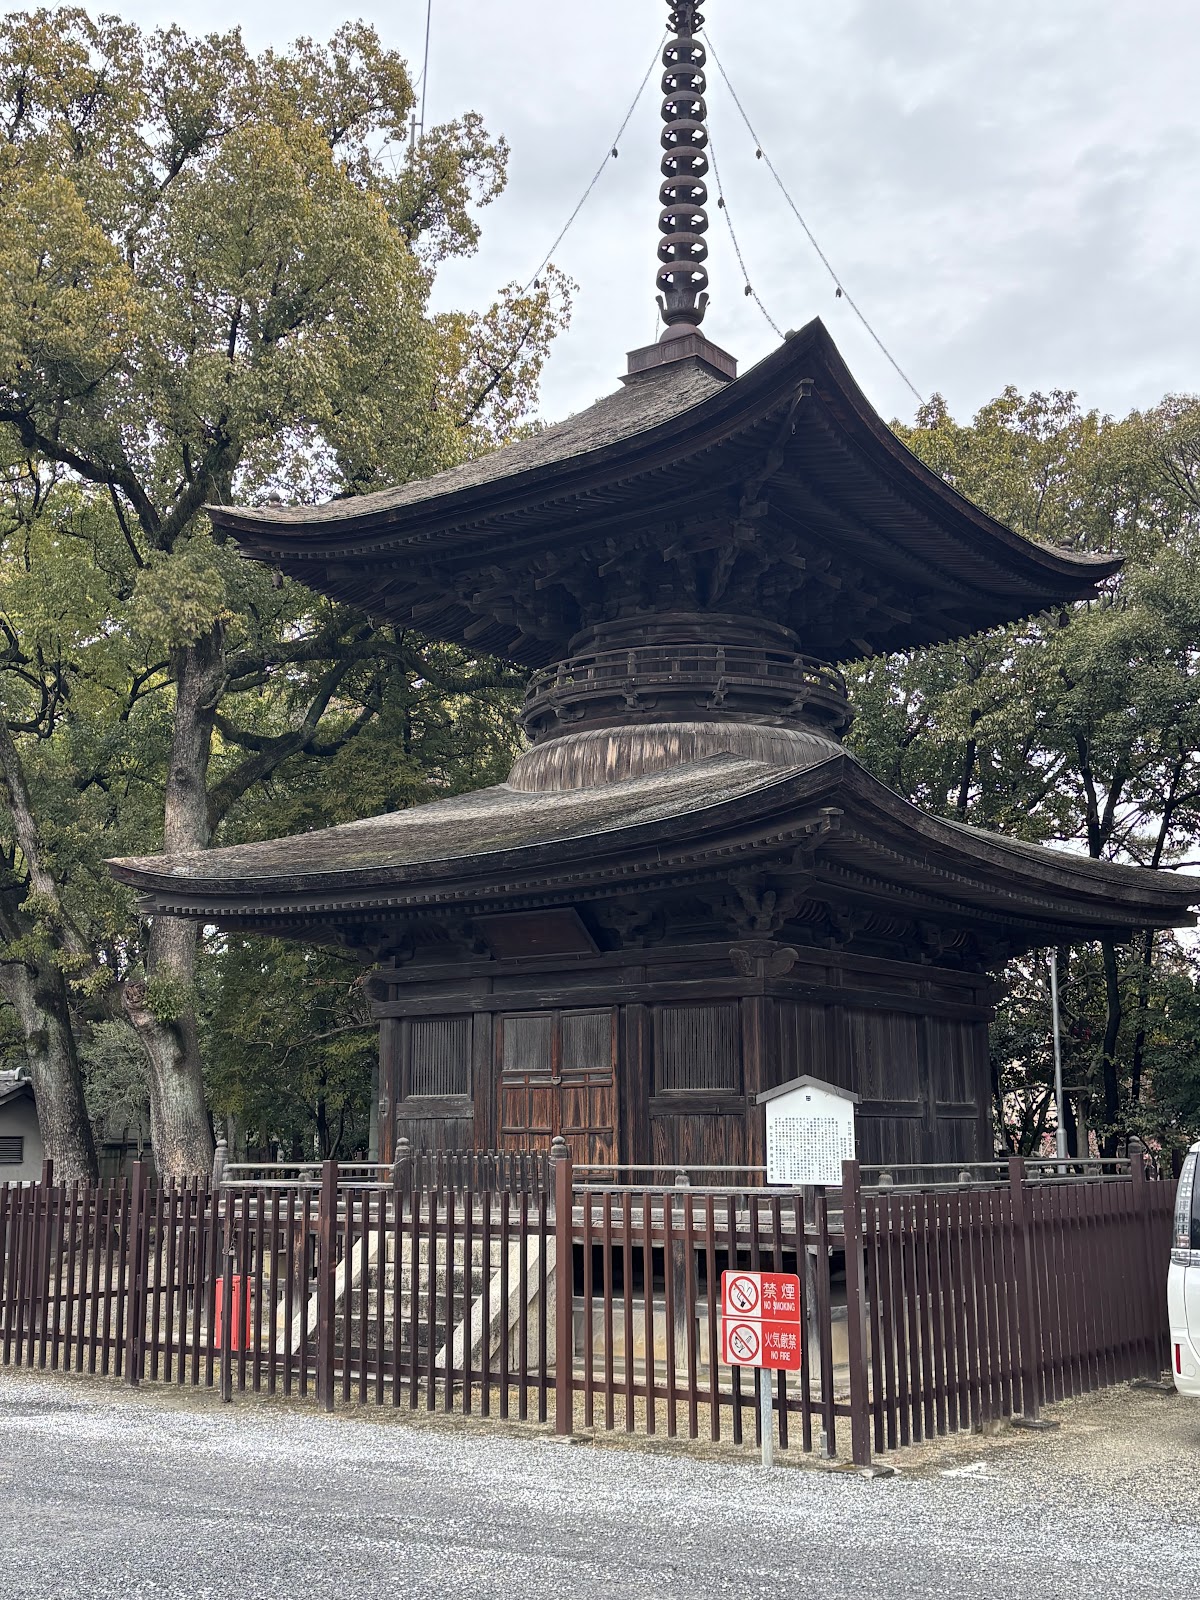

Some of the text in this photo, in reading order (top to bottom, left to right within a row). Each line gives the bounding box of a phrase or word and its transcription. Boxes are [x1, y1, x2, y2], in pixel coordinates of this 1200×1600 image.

[763, 1301, 795, 1312] NO SMOKING
[764, 1332, 796, 1350] 火気厳禁
[770, 1352, 790, 1361] NO FIRE
